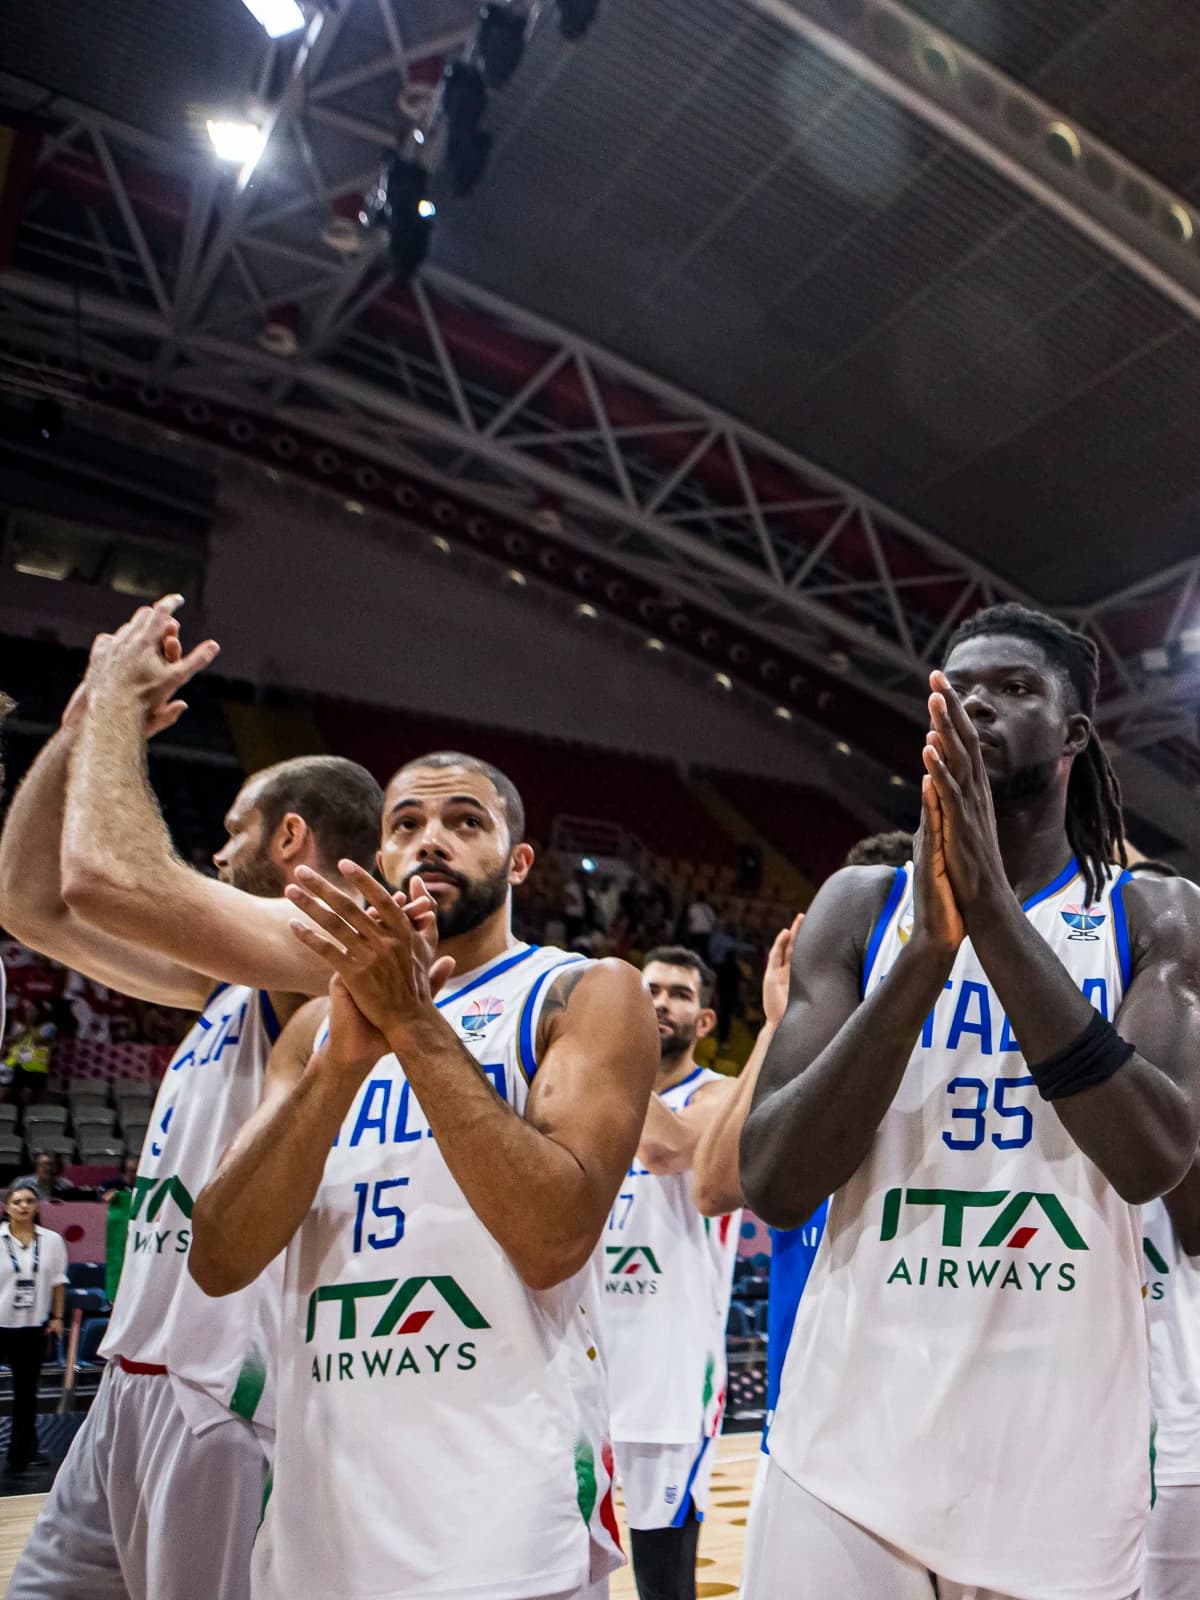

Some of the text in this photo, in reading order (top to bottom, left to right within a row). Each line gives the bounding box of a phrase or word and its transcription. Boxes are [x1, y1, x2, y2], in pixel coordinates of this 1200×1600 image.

[1066, 929, 1101, 941] 25
[942, 1077, 1034, 1150] 35
[129, 1175, 196, 1223] TA
[353, 1177, 410, 1253] 15
[609, 1194, 634, 1230] 17
[880, 1188, 1090, 1251] ITA
[605, 1280, 658, 1295] WAYS
[887, 1257, 1076, 1292] AIRWAYS
[305, 1275, 492, 1343] ITA
[312, 1342, 477, 1383] AIRWAYS
